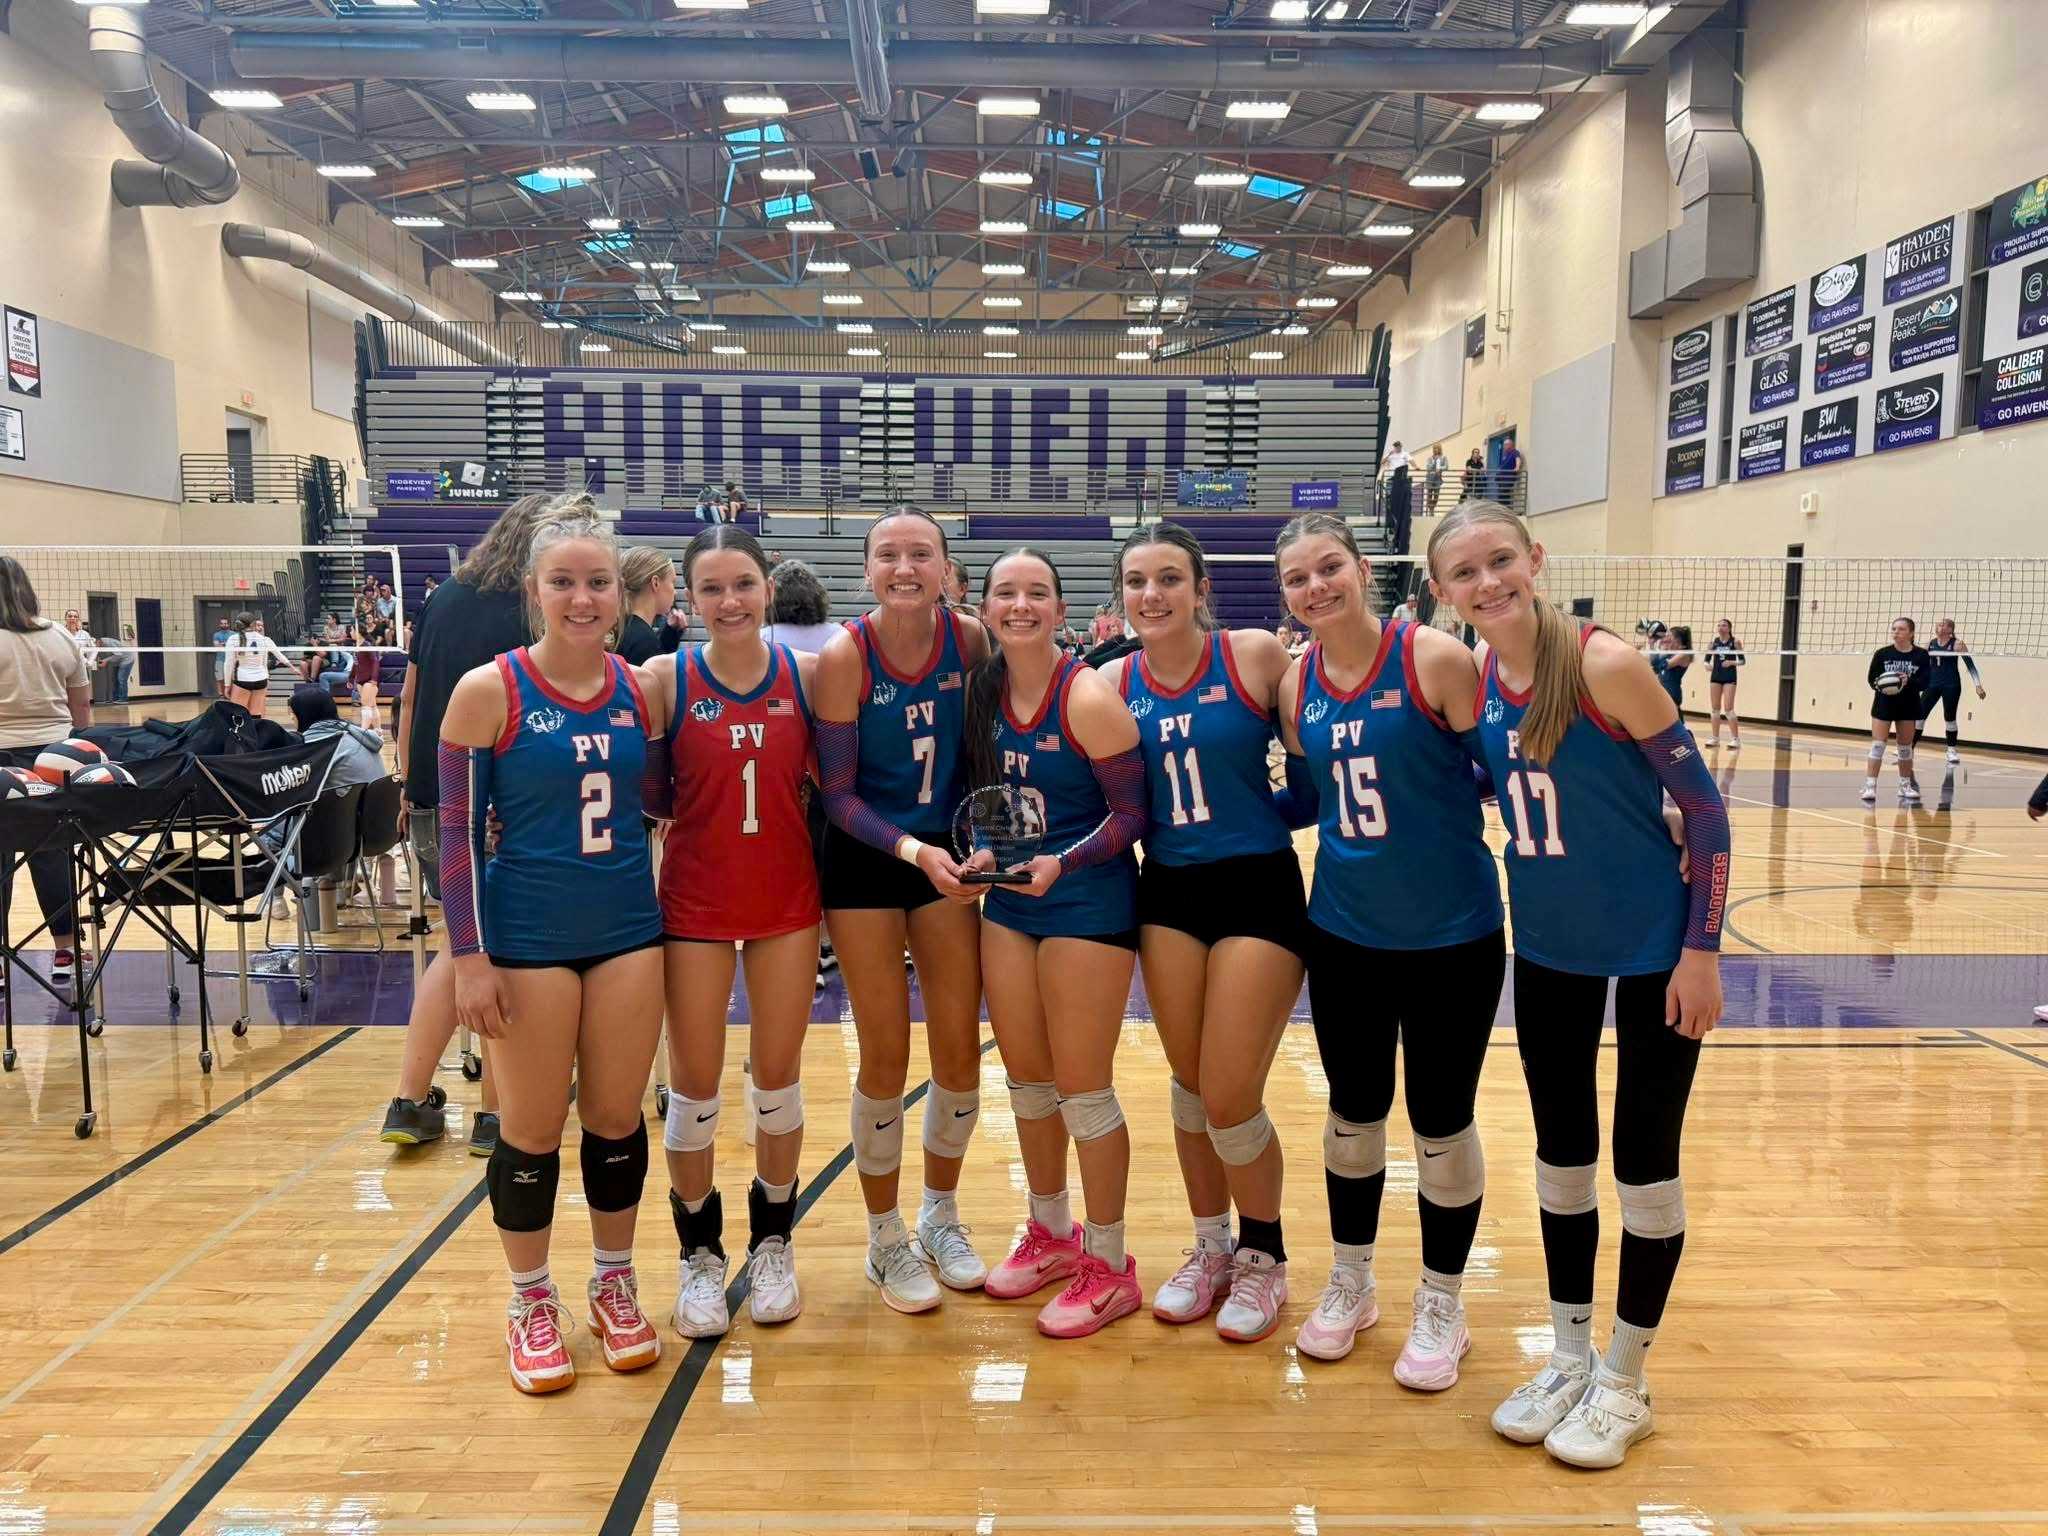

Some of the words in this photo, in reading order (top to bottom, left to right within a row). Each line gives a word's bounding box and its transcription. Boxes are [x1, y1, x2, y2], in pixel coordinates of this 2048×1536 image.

[1902, 222, 1951, 254] HAYDEN
[2004, 235, 2030, 249] PROUDLY
[2004, 249, 2017, 257] OUR
[2018, 239, 2038, 253] RAVEN
[1901, 242, 1949, 273] HOMES
[1822, 313, 1830, 323] GO
[1832, 303, 1859, 319] RAVENS!
[1894, 312, 1921, 330] Desert
[2039, 315, 2048, 326] G
[1820, 331, 1844, 346] Westside
[1845, 328, 1856, 337] One
[1858, 322, 1872, 332] Stop
[1892, 326, 1916, 342] Peaks
[1902, 346, 1922, 356] PROUDLY
[1923, 336, 1955, 350] SUPPORTING
[1930, 344, 1955, 356] ATHLETES
[1998, 349, 2044, 374] CALIBER
[1760, 369, 1788, 390] GLASS
[1996, 369, 2042, 391] COLLISION
[1763, 395, 1771, 404] GO
[1895, 392, 1930, 410] STEVENS
[1819, 405, 1838, 429] BWI
[1998, 408, 2012, 420] GO
[1889, 432, 1900, 442] GO
[1901, 425, 1933, 440] RAVENS!
[1813, 450, 1822, 459] GO
[1823, 444, 1849, 457] RAVENS!
[448, 488, 499, 498] JUNIORS
[905, 700, 935, 730] PV
[729, 723, 766, 750] PV
[1159, 713, 1193, 743] PV
[1331, 720, 1364, 750] PV
[572, 734, 611, 762] PV
[912, 736, 936, 804] 7
[1003, 750, 1030, 779] PV
[261, 763, 312, 796] molten
[1163, 747, 1211, 826] 11
[742, 759, 761, 836] 1
[1332, 757, 1389, 838] 15
[581, 772, 613, 855] 2
[1506, 771, 1567, 858] 17
[1705, 851, 1730, 934] BADGERS
